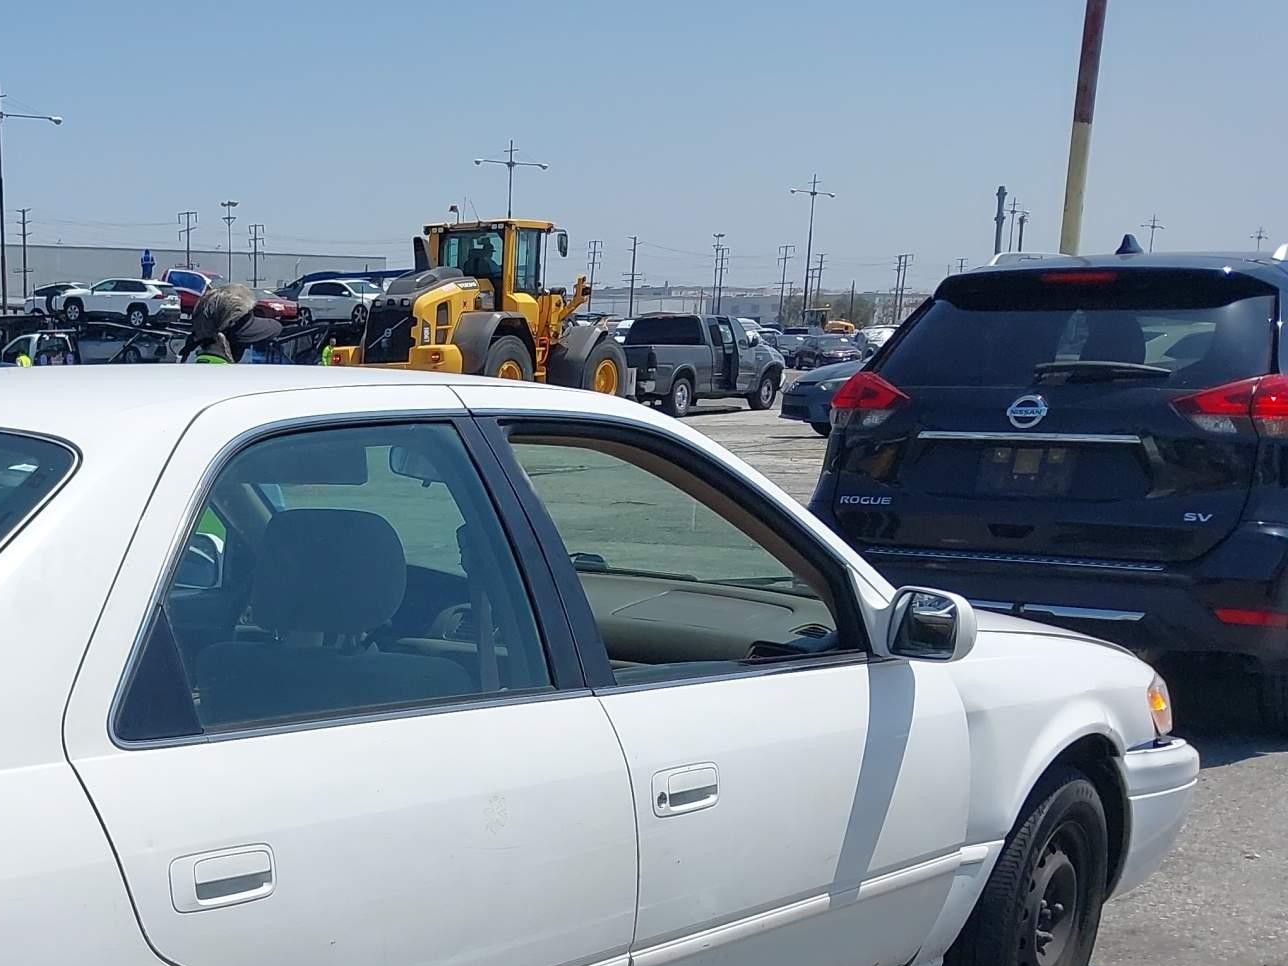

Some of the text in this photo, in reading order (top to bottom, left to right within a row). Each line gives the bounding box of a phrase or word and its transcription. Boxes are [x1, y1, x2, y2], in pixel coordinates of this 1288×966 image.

[1010, 408, 1043, 416] NISSAN
[840, 495, 893, 505] ROGUE
[1183, 512, 1214, 522] SV
